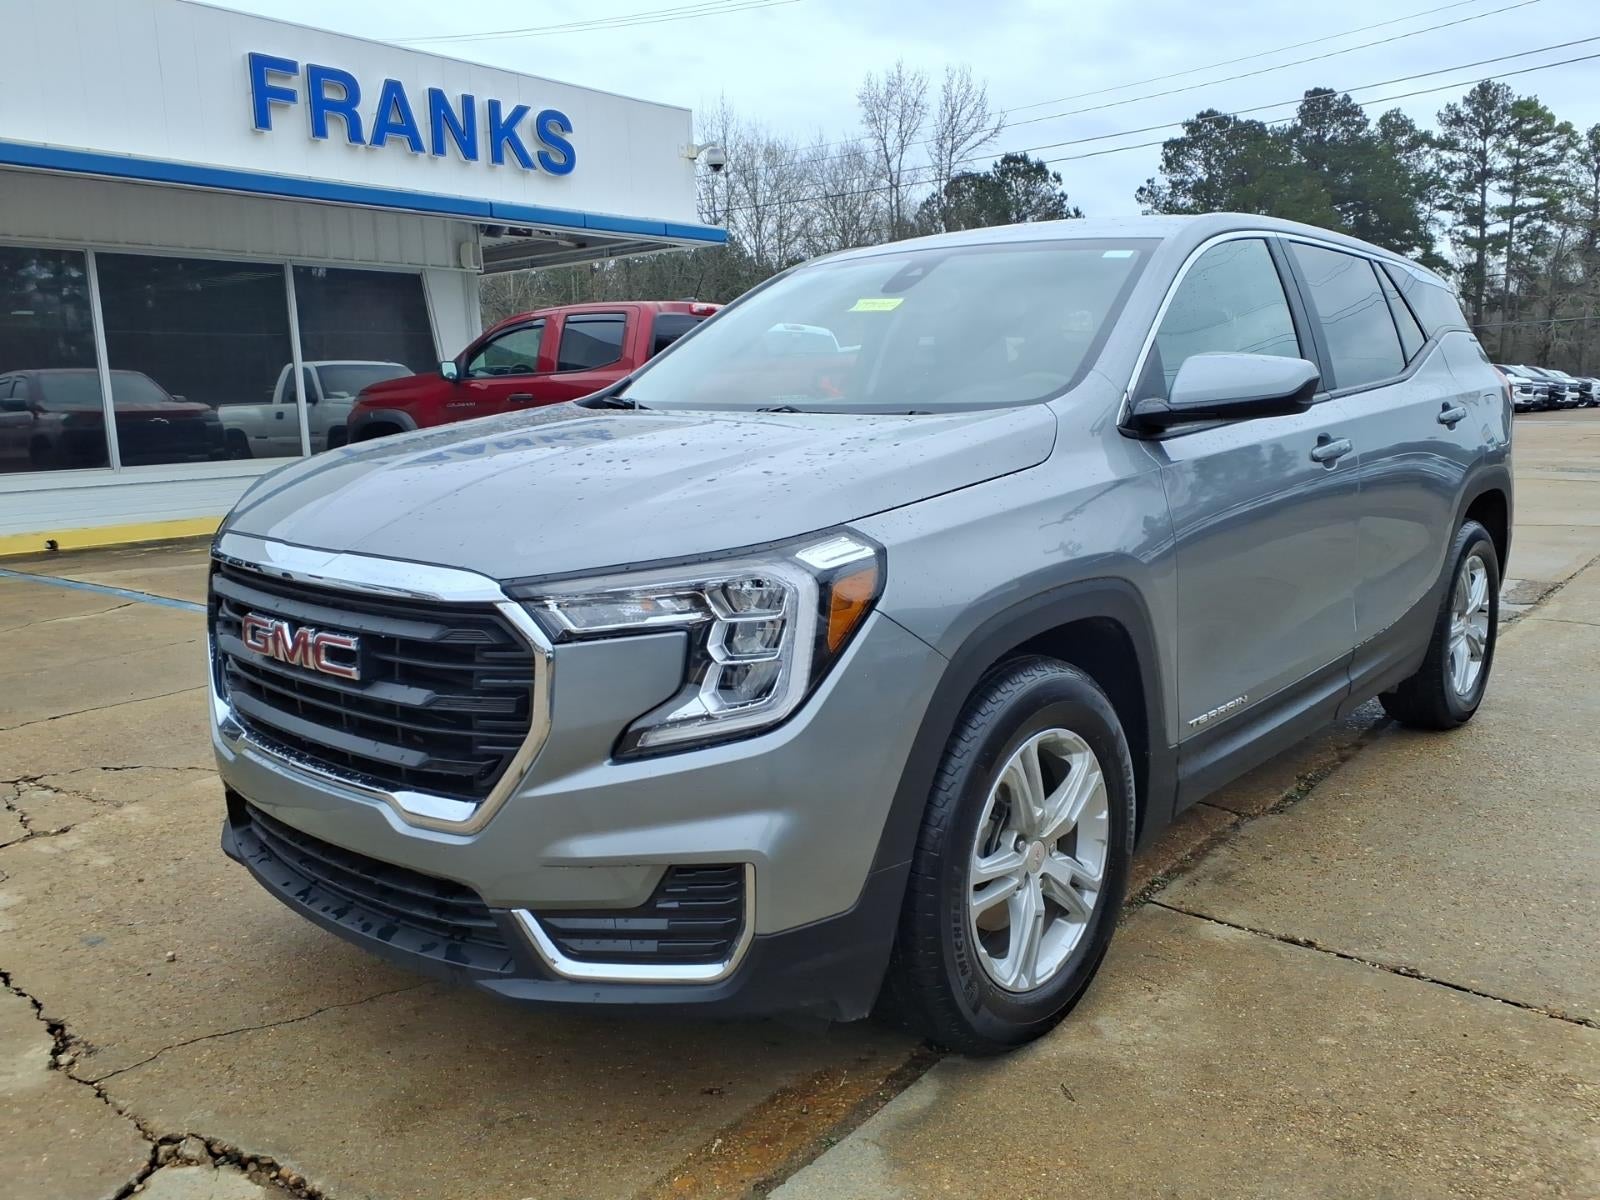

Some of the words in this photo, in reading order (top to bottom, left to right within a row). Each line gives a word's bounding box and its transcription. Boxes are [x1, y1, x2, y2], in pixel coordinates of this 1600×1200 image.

[248, 51, 577, 176] FRANKS
[242, 612, 361, 680] GMC
[1188, 694, 1248, 727] TERRAIN
